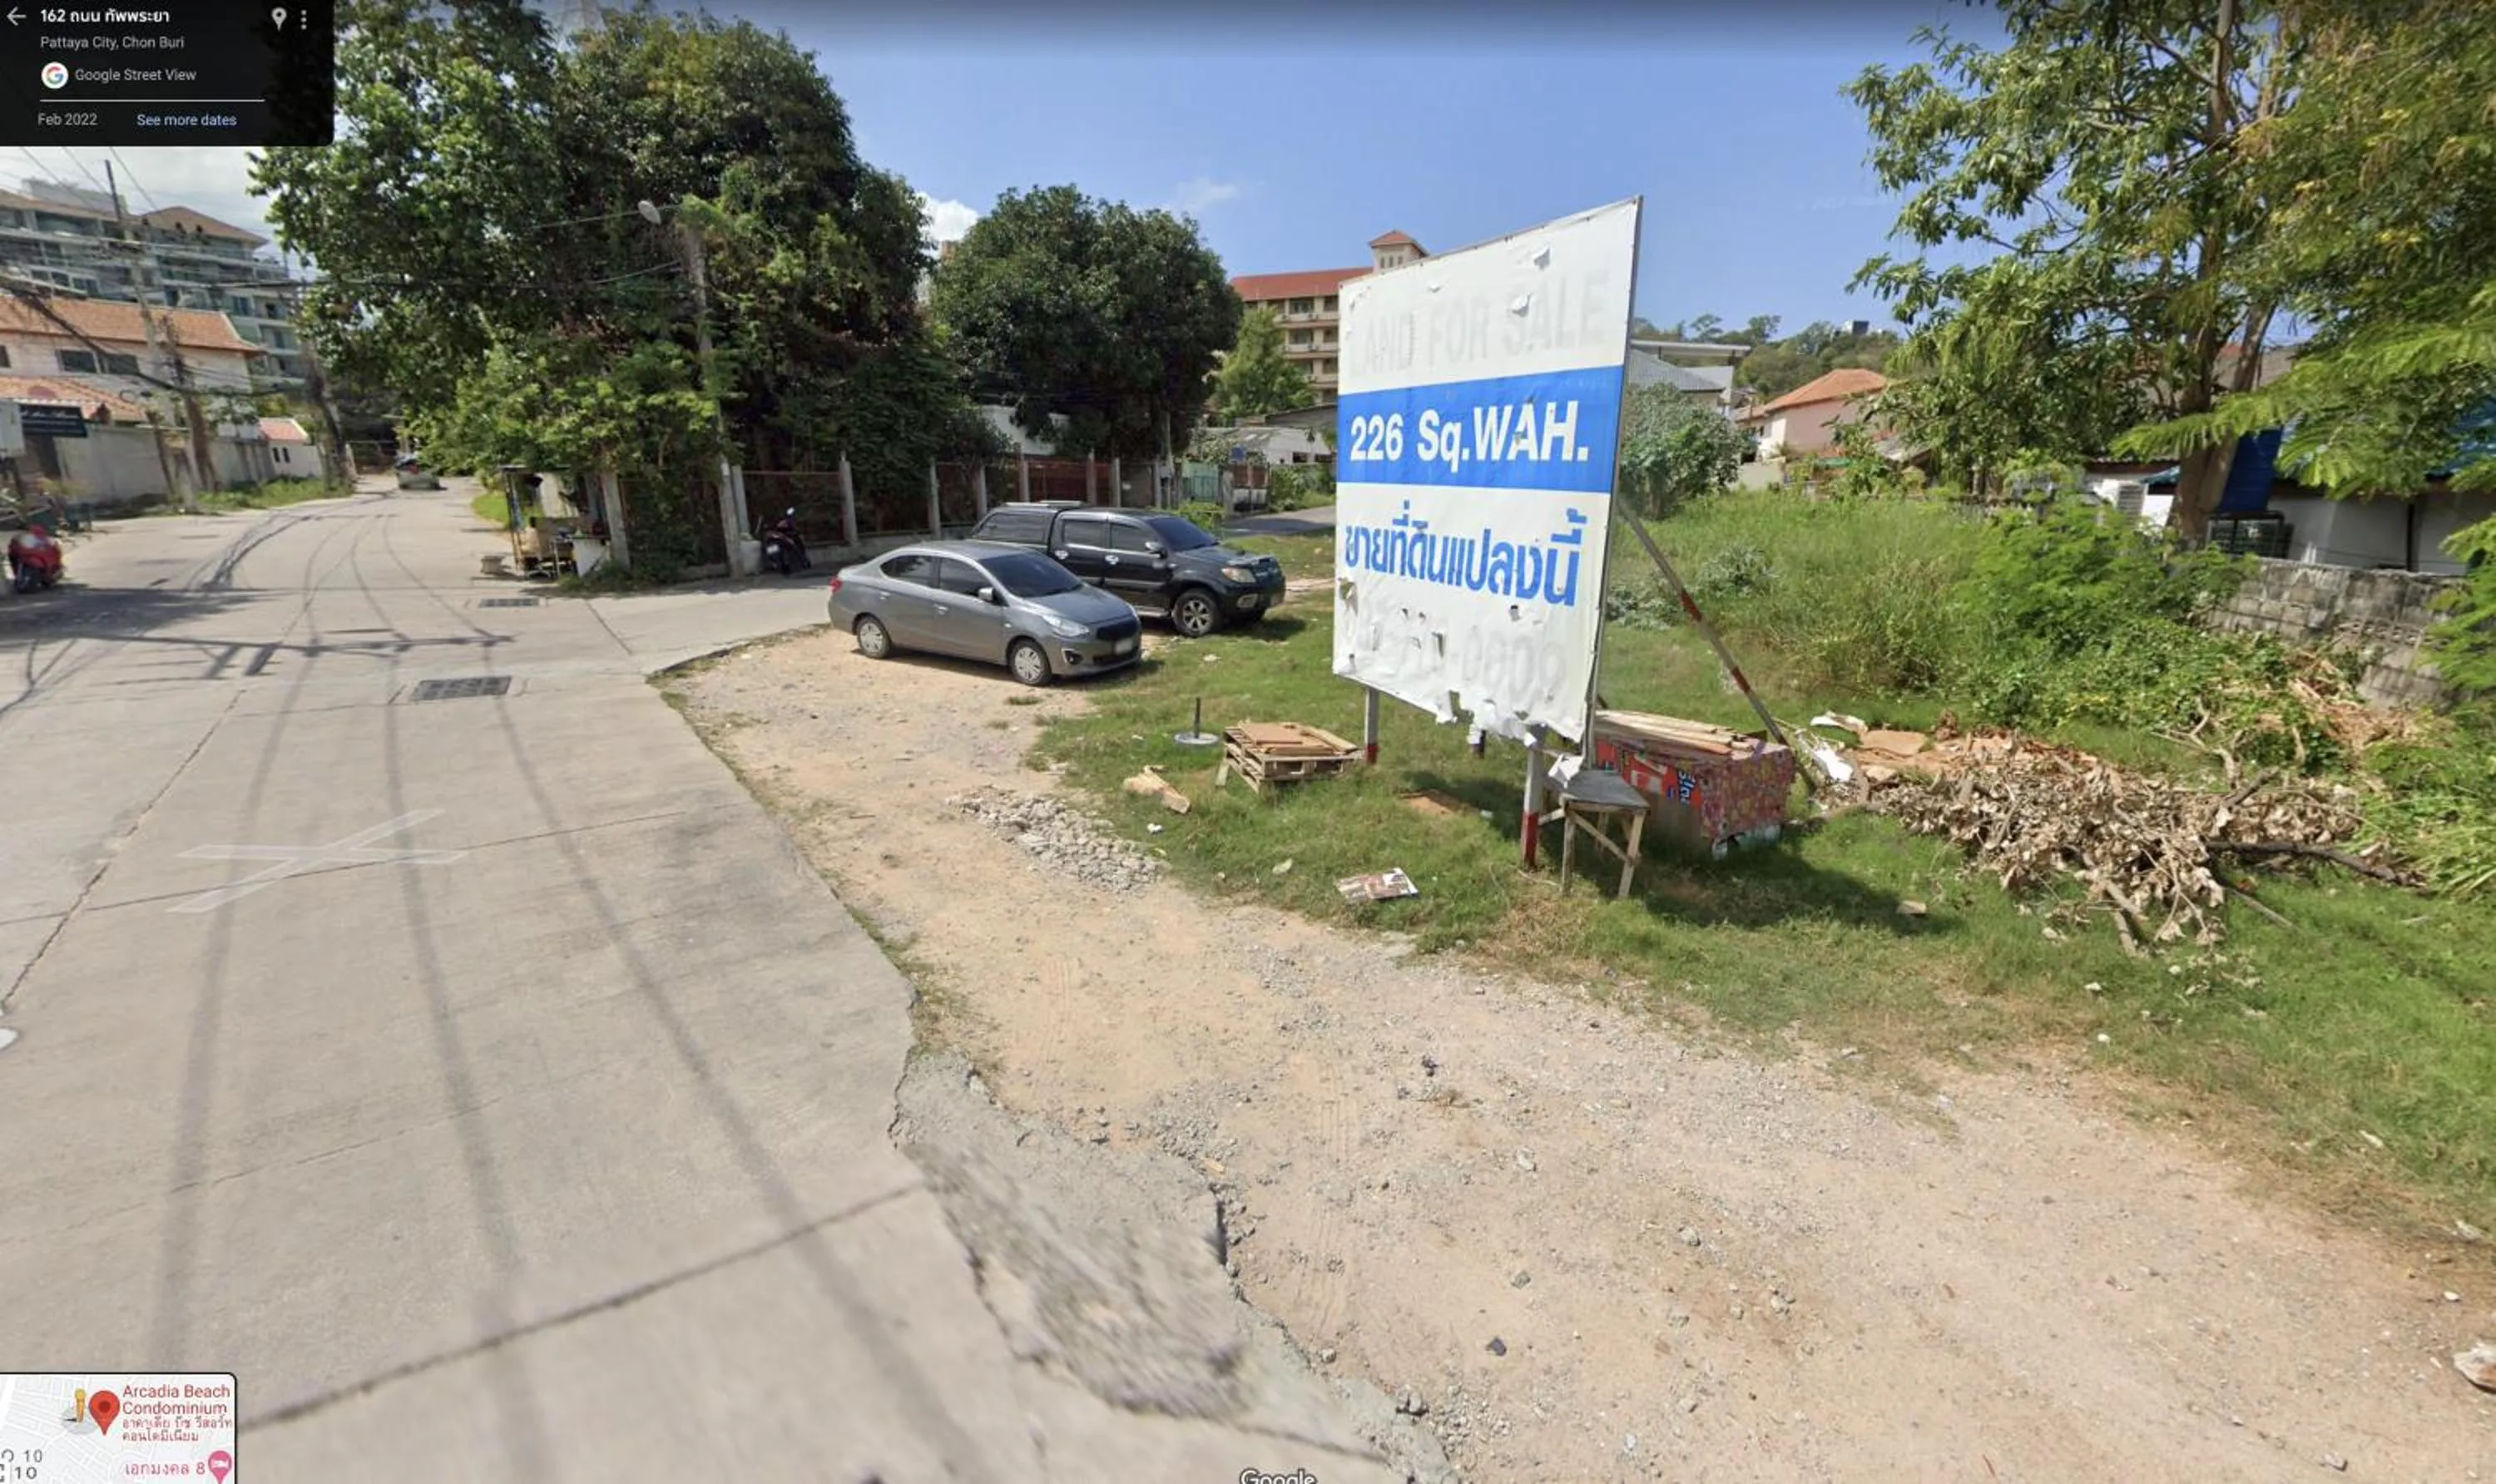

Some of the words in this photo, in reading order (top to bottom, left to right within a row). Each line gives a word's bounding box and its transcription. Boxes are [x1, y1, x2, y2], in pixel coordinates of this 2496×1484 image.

[1350, 413, 1403, 461] 226
[1345, 498, 1588, 606] ขายที่ดินแปลงนี้
